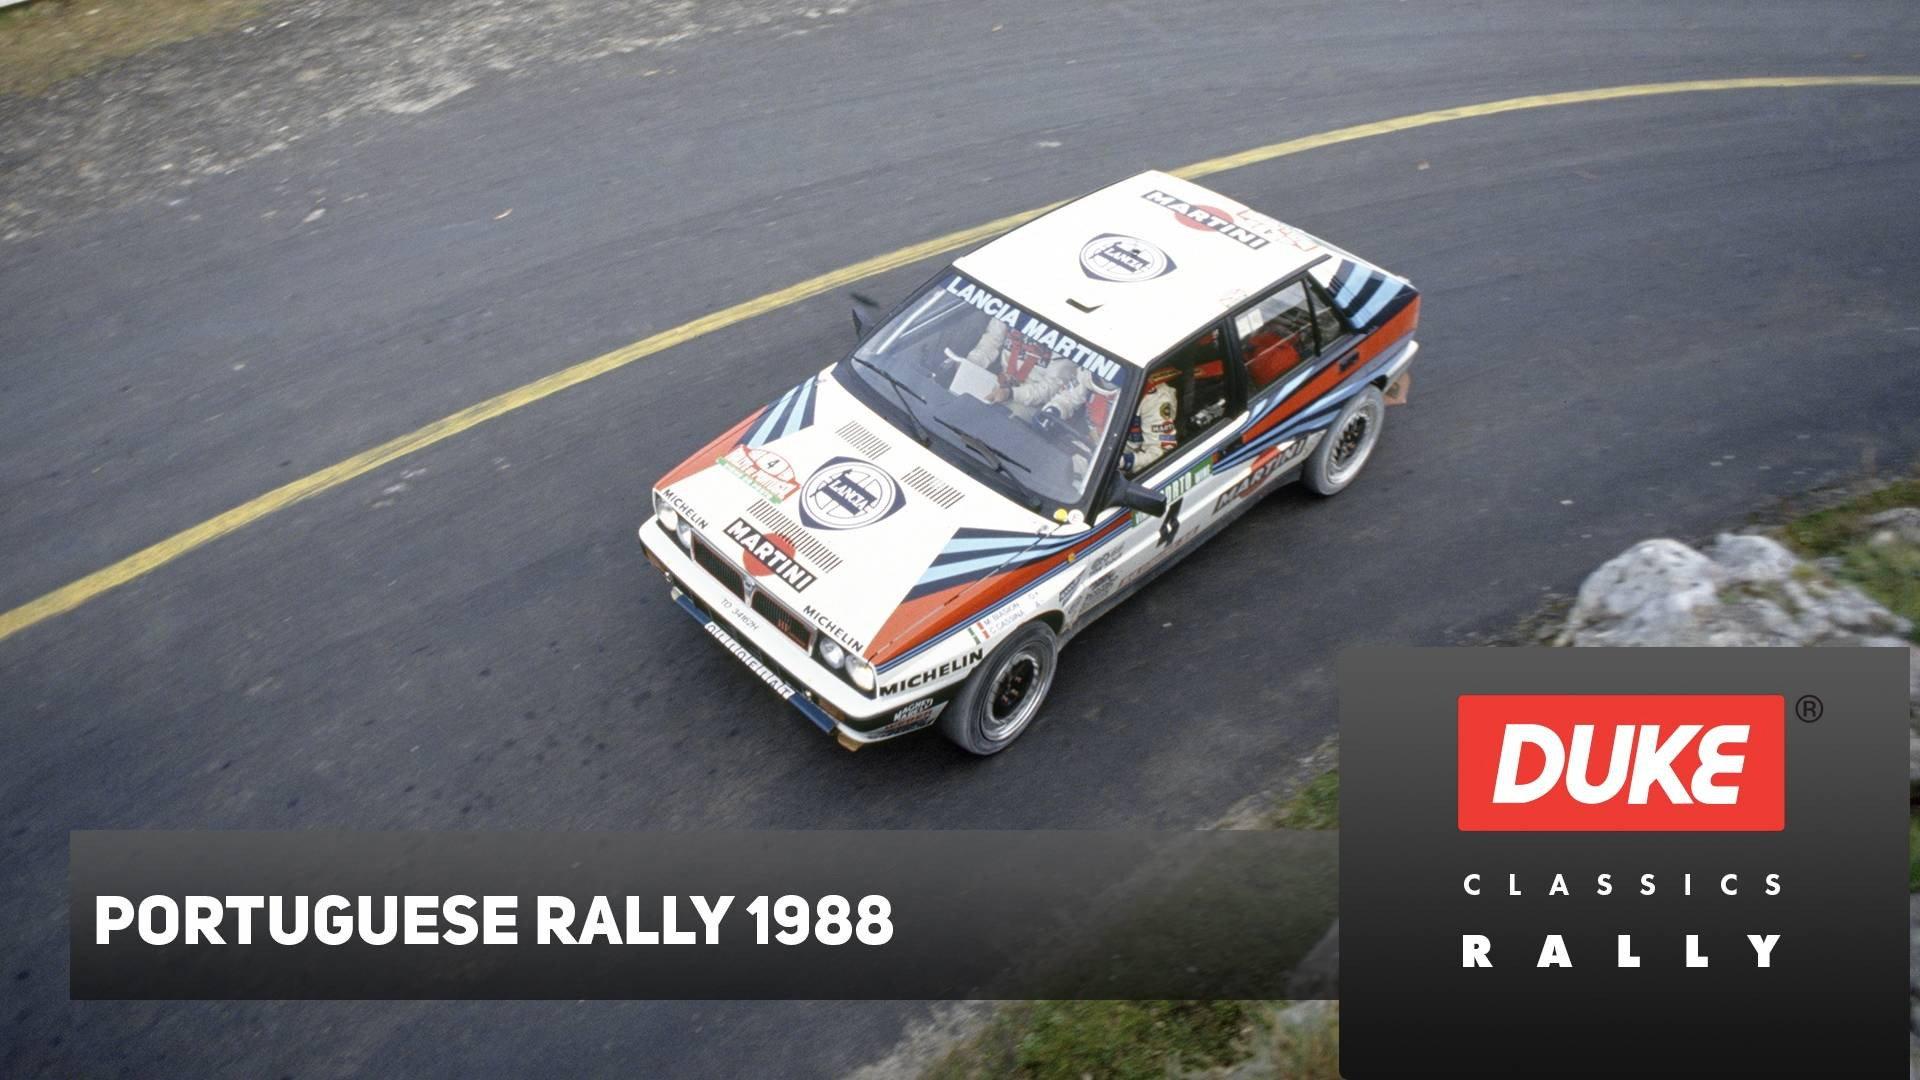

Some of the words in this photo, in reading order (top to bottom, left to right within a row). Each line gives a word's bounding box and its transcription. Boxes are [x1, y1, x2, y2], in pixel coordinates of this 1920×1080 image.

[1145, 191, 1268, 249] MARTINI
[946, 276, 1020, 328] LANCIA
[1021, 318, 1121, 381] MARTINI
[767, 459, 780, 469] 4
[1216, 437, 1307, 511] MARTINI
[663, 489, 708, 530] MICHELIN
[828, 478, 871, 511] LANCIA
[1156, 497, 1183, 548] 4
[727, 518, 816, 592] MARTINI
[803, 605, 864, 653] MICHELIN
[879, 649, 983, 696] MICHELIN
